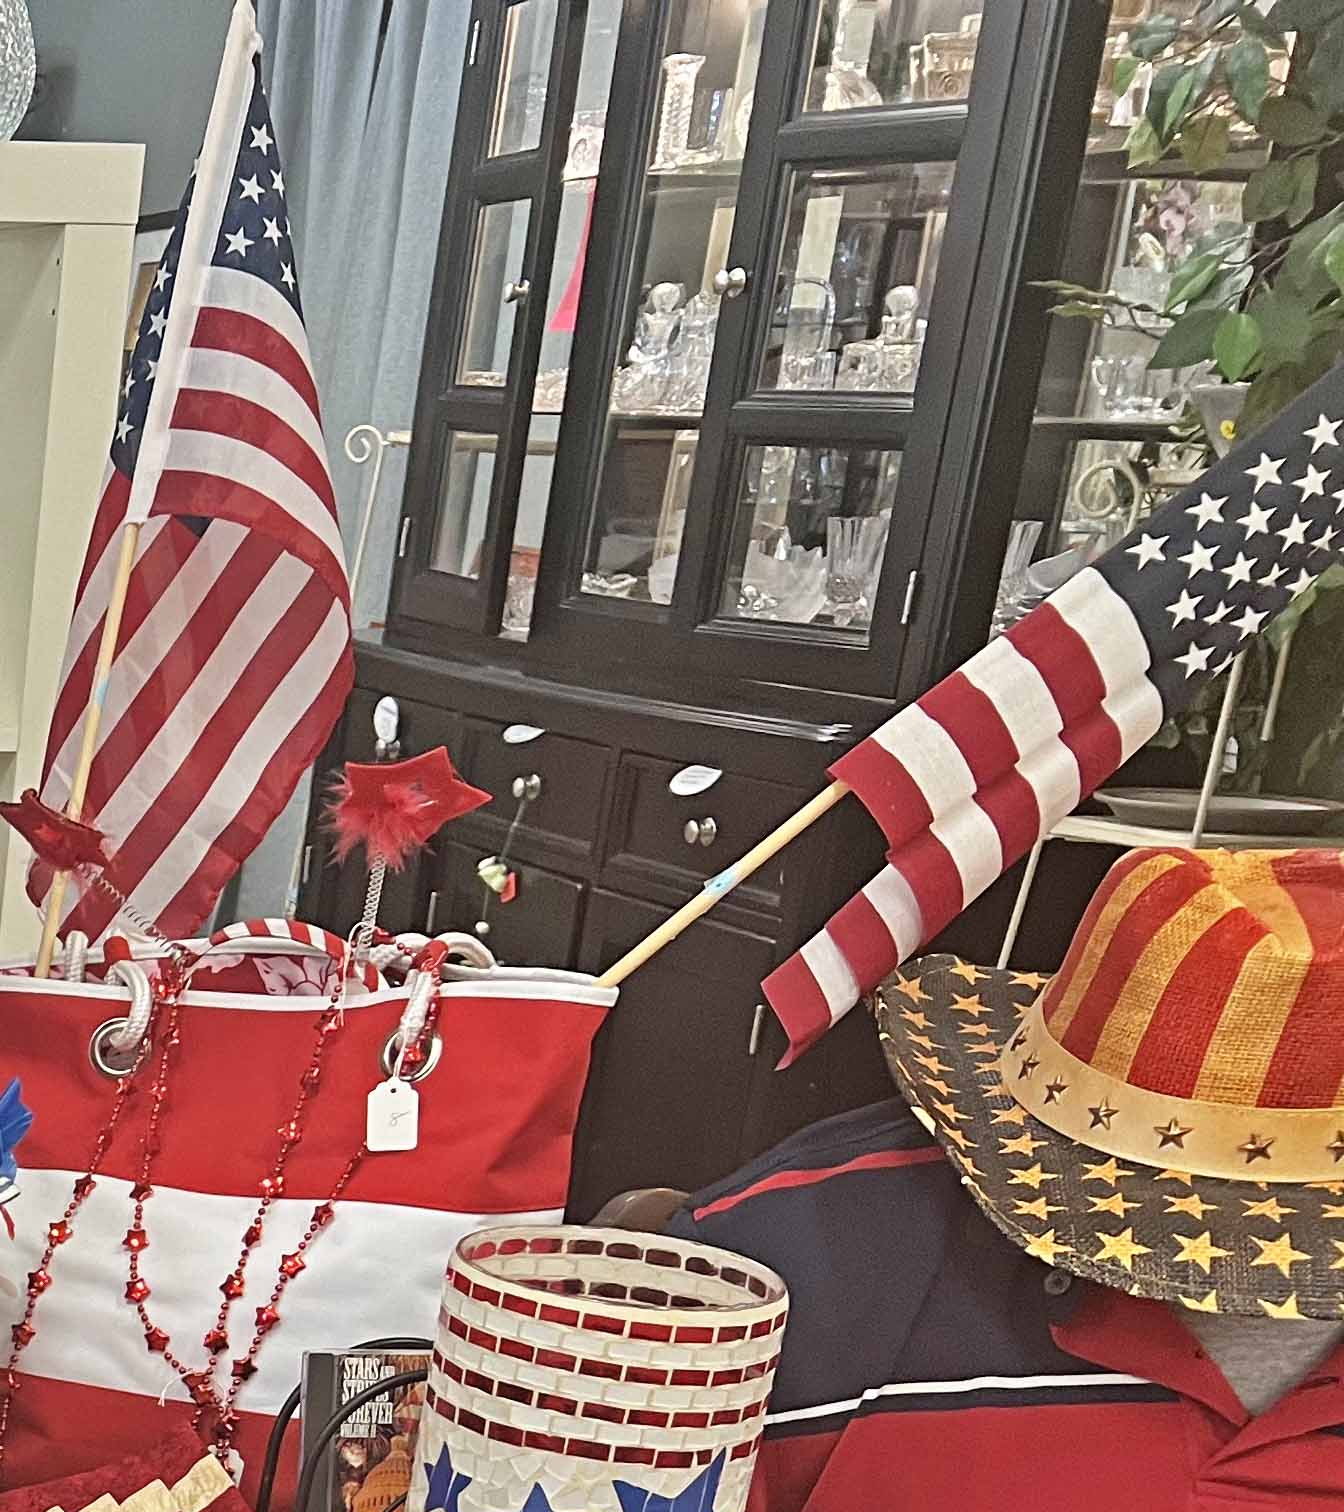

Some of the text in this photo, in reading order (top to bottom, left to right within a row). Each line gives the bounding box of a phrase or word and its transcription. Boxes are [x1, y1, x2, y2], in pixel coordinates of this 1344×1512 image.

[343, 1357, 380, 1380] STARS
[341, 1380, 390, 1406] STRS
[343, 1402, 393, 1424] OREVER
